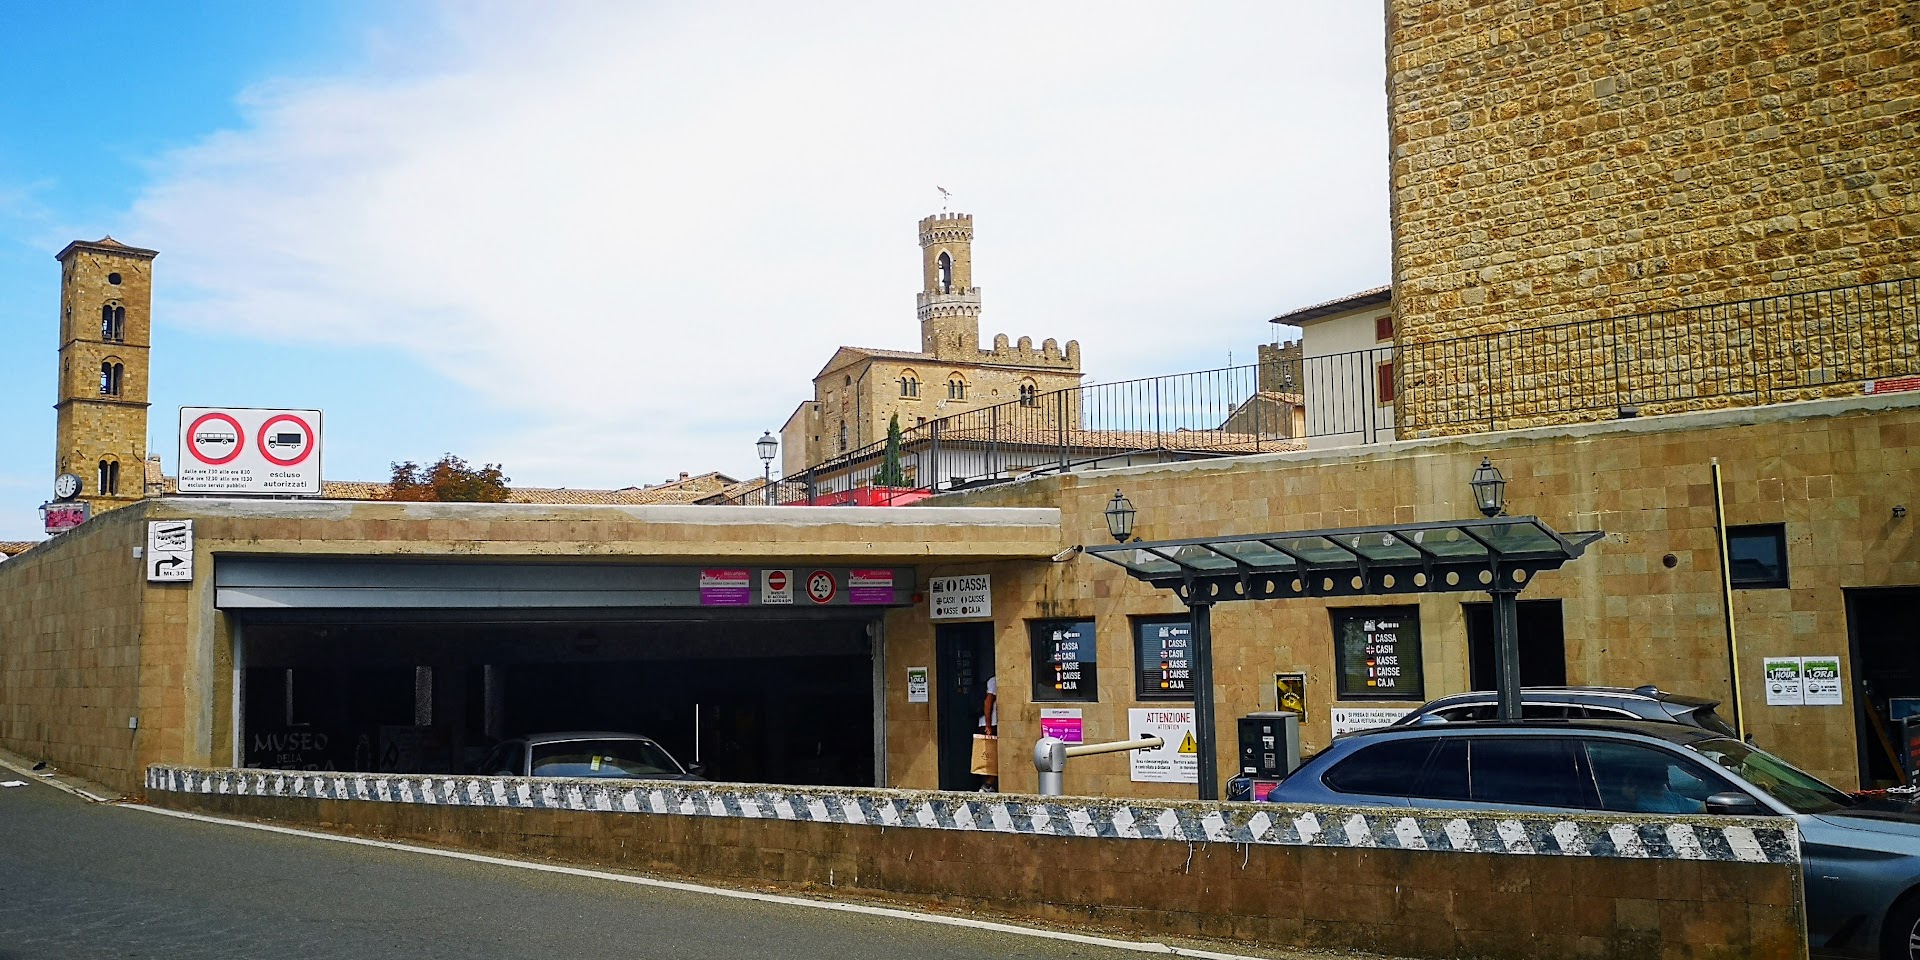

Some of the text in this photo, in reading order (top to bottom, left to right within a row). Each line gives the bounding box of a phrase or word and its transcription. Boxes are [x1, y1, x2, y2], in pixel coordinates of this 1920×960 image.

[263, 480, 307, 488] autorizzati
[959, 577, 988, 592] CASSA
[943, 594, 985, 604] CASH CAISSE
[943, 606, 981, 615] KASSE CAJA
[1375, 633, 1398, 642] CASSA
[1061, 642, 1079, 651] CASSA
[1168, 639, 1187, 648] CASSA
[1168, 649, 1184, 658] CASH
[1375, 644, 1394, 654] CASH
[1061, 652, 1076, 660] CASH
[1376, 656, 1399, 665] KASSE
[1061, 662, 1080, 670] KASSE
[1168, 660, 1188, 668] KASSE
[1062, 671, 1081, 680] CAISSE
[1169, 670, 1189, 679] CAISSE
[1377, 667, 1401, 676] CAISSE
[1769, 670, 1796, 680] 1 HOUR
[1806, 669, 1834, 679] 1 ORA
[1062, 681, 1078, 690] CAJA
[1169, 680, 1185, 689] CAJA
[1377, 678, 1395, 688] CAJA
[1146, 712, 1191, 723] ATTENZIONE
[253, 732, 329, 753] MUSEO
